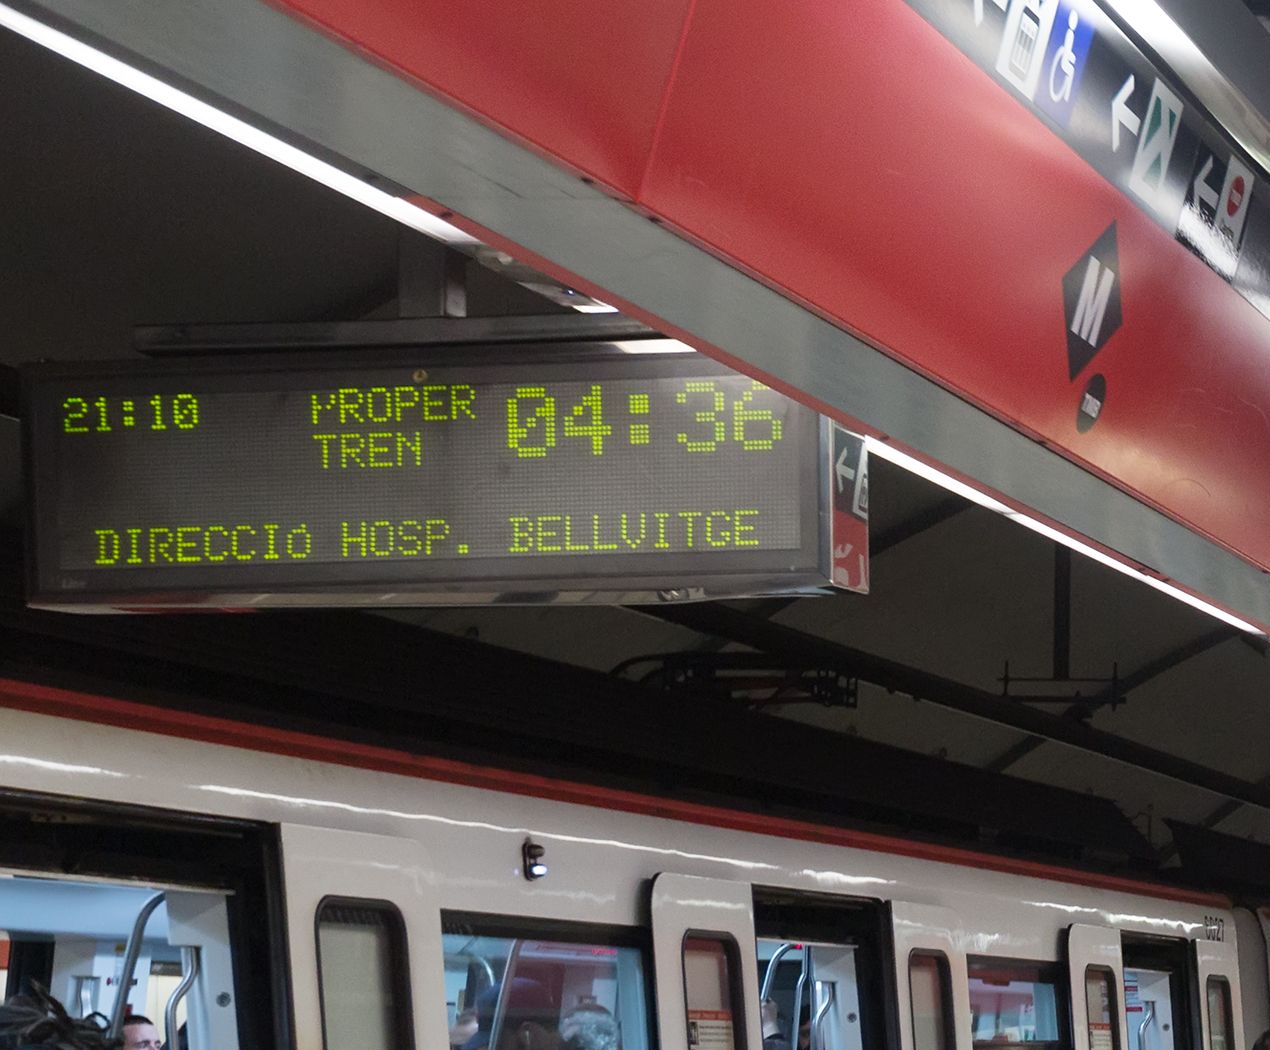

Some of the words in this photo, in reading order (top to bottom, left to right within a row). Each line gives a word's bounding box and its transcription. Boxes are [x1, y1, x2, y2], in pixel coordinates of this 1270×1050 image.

[63, 393, 200, 434] 21:10
[506, 379, 783, 458] 04:36
[312, 431, 422, 469] TREN
[341, 518, 471, 559] HOSP.
[507, 510, 761, 554] BELLVITGE
